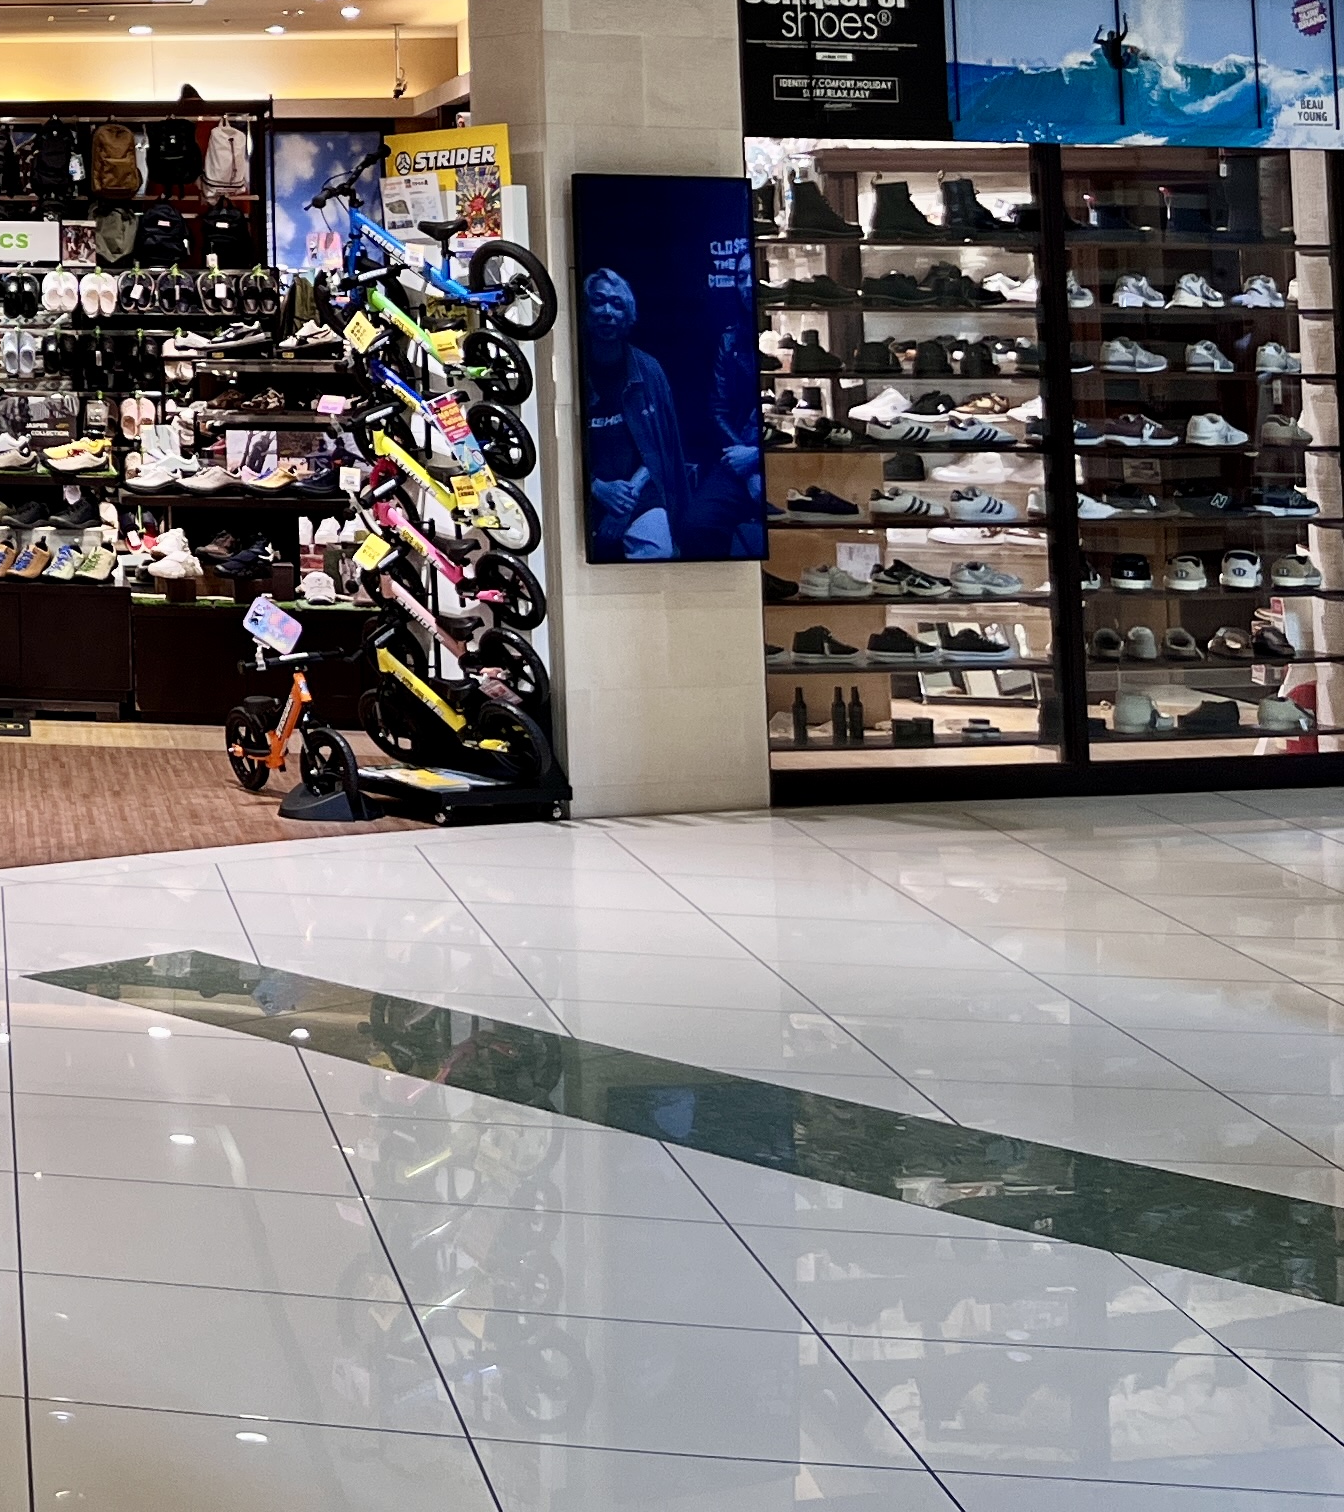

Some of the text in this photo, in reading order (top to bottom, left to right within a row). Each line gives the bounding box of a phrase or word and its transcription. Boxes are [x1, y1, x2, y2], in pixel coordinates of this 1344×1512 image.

[1300, 99, 1324, 109] BEAU
[1297, 111, 1328, 122] YOUNG
[413, 145, 495, 172] STRIDER
